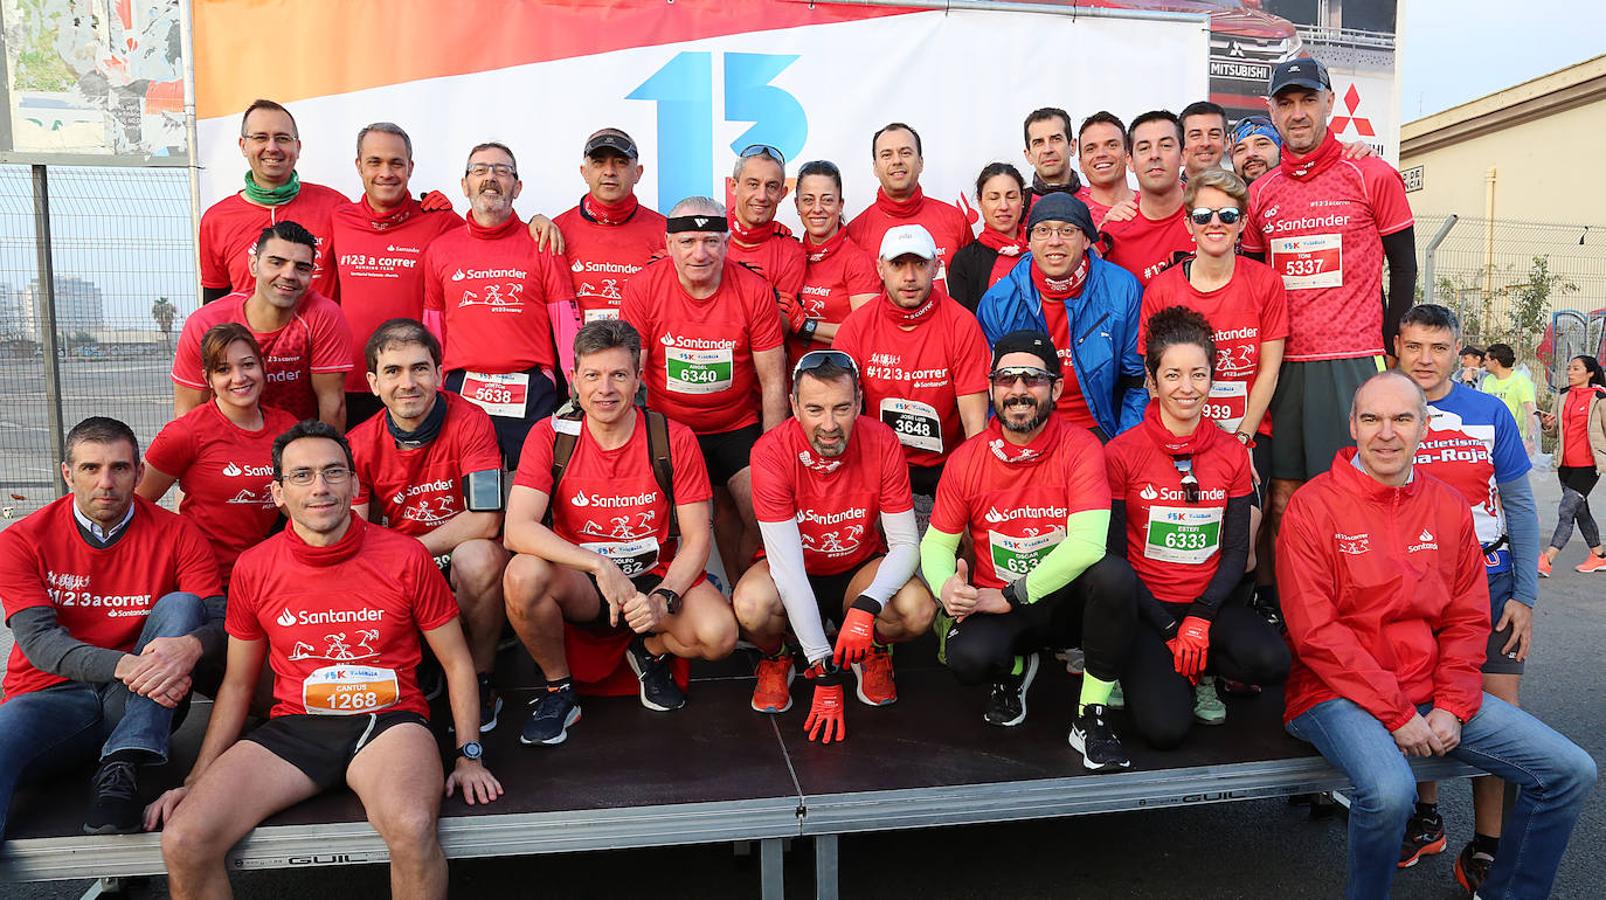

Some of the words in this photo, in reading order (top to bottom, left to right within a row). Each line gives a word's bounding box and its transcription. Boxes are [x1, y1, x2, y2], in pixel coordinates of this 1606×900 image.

[1210, 62, 1269, 79] MITSUBISHI
[1276, 213, 1350, 232] Santander
[368, 257, 376, 266] a
[378, 257, 417, 268] correr
[1286, 259, 1324, 275] 5337
[466, 267, 528, 279] Santander
[675, 335, 737, 349] Santander
[681, 369, 717, 382] 6340
[903, 372, 911, 381] a
[911, 368, 948, 380] correr
[475, 388, 511, 403] 5638
[1202, 404, 1232, 419] 939
[895, 420, 930, 437] 3648
[591, 492, 657, 508] Santander
[806, 507, 866, 525] Santander
[1001, 505, 1067, 521] Santander
[1165, 533, 1206, 549] 6333
[1007, 558, 1039, 573] 633
[93, 598, 101, 606] a
[102, 594, 151, 607] correr
[298, 608, 385, 625] Santander
[326, 692, 377, 709] 1268
[1182, 791, 1246, 803] GUIL
[288, 854, 369, 865] GUIL
